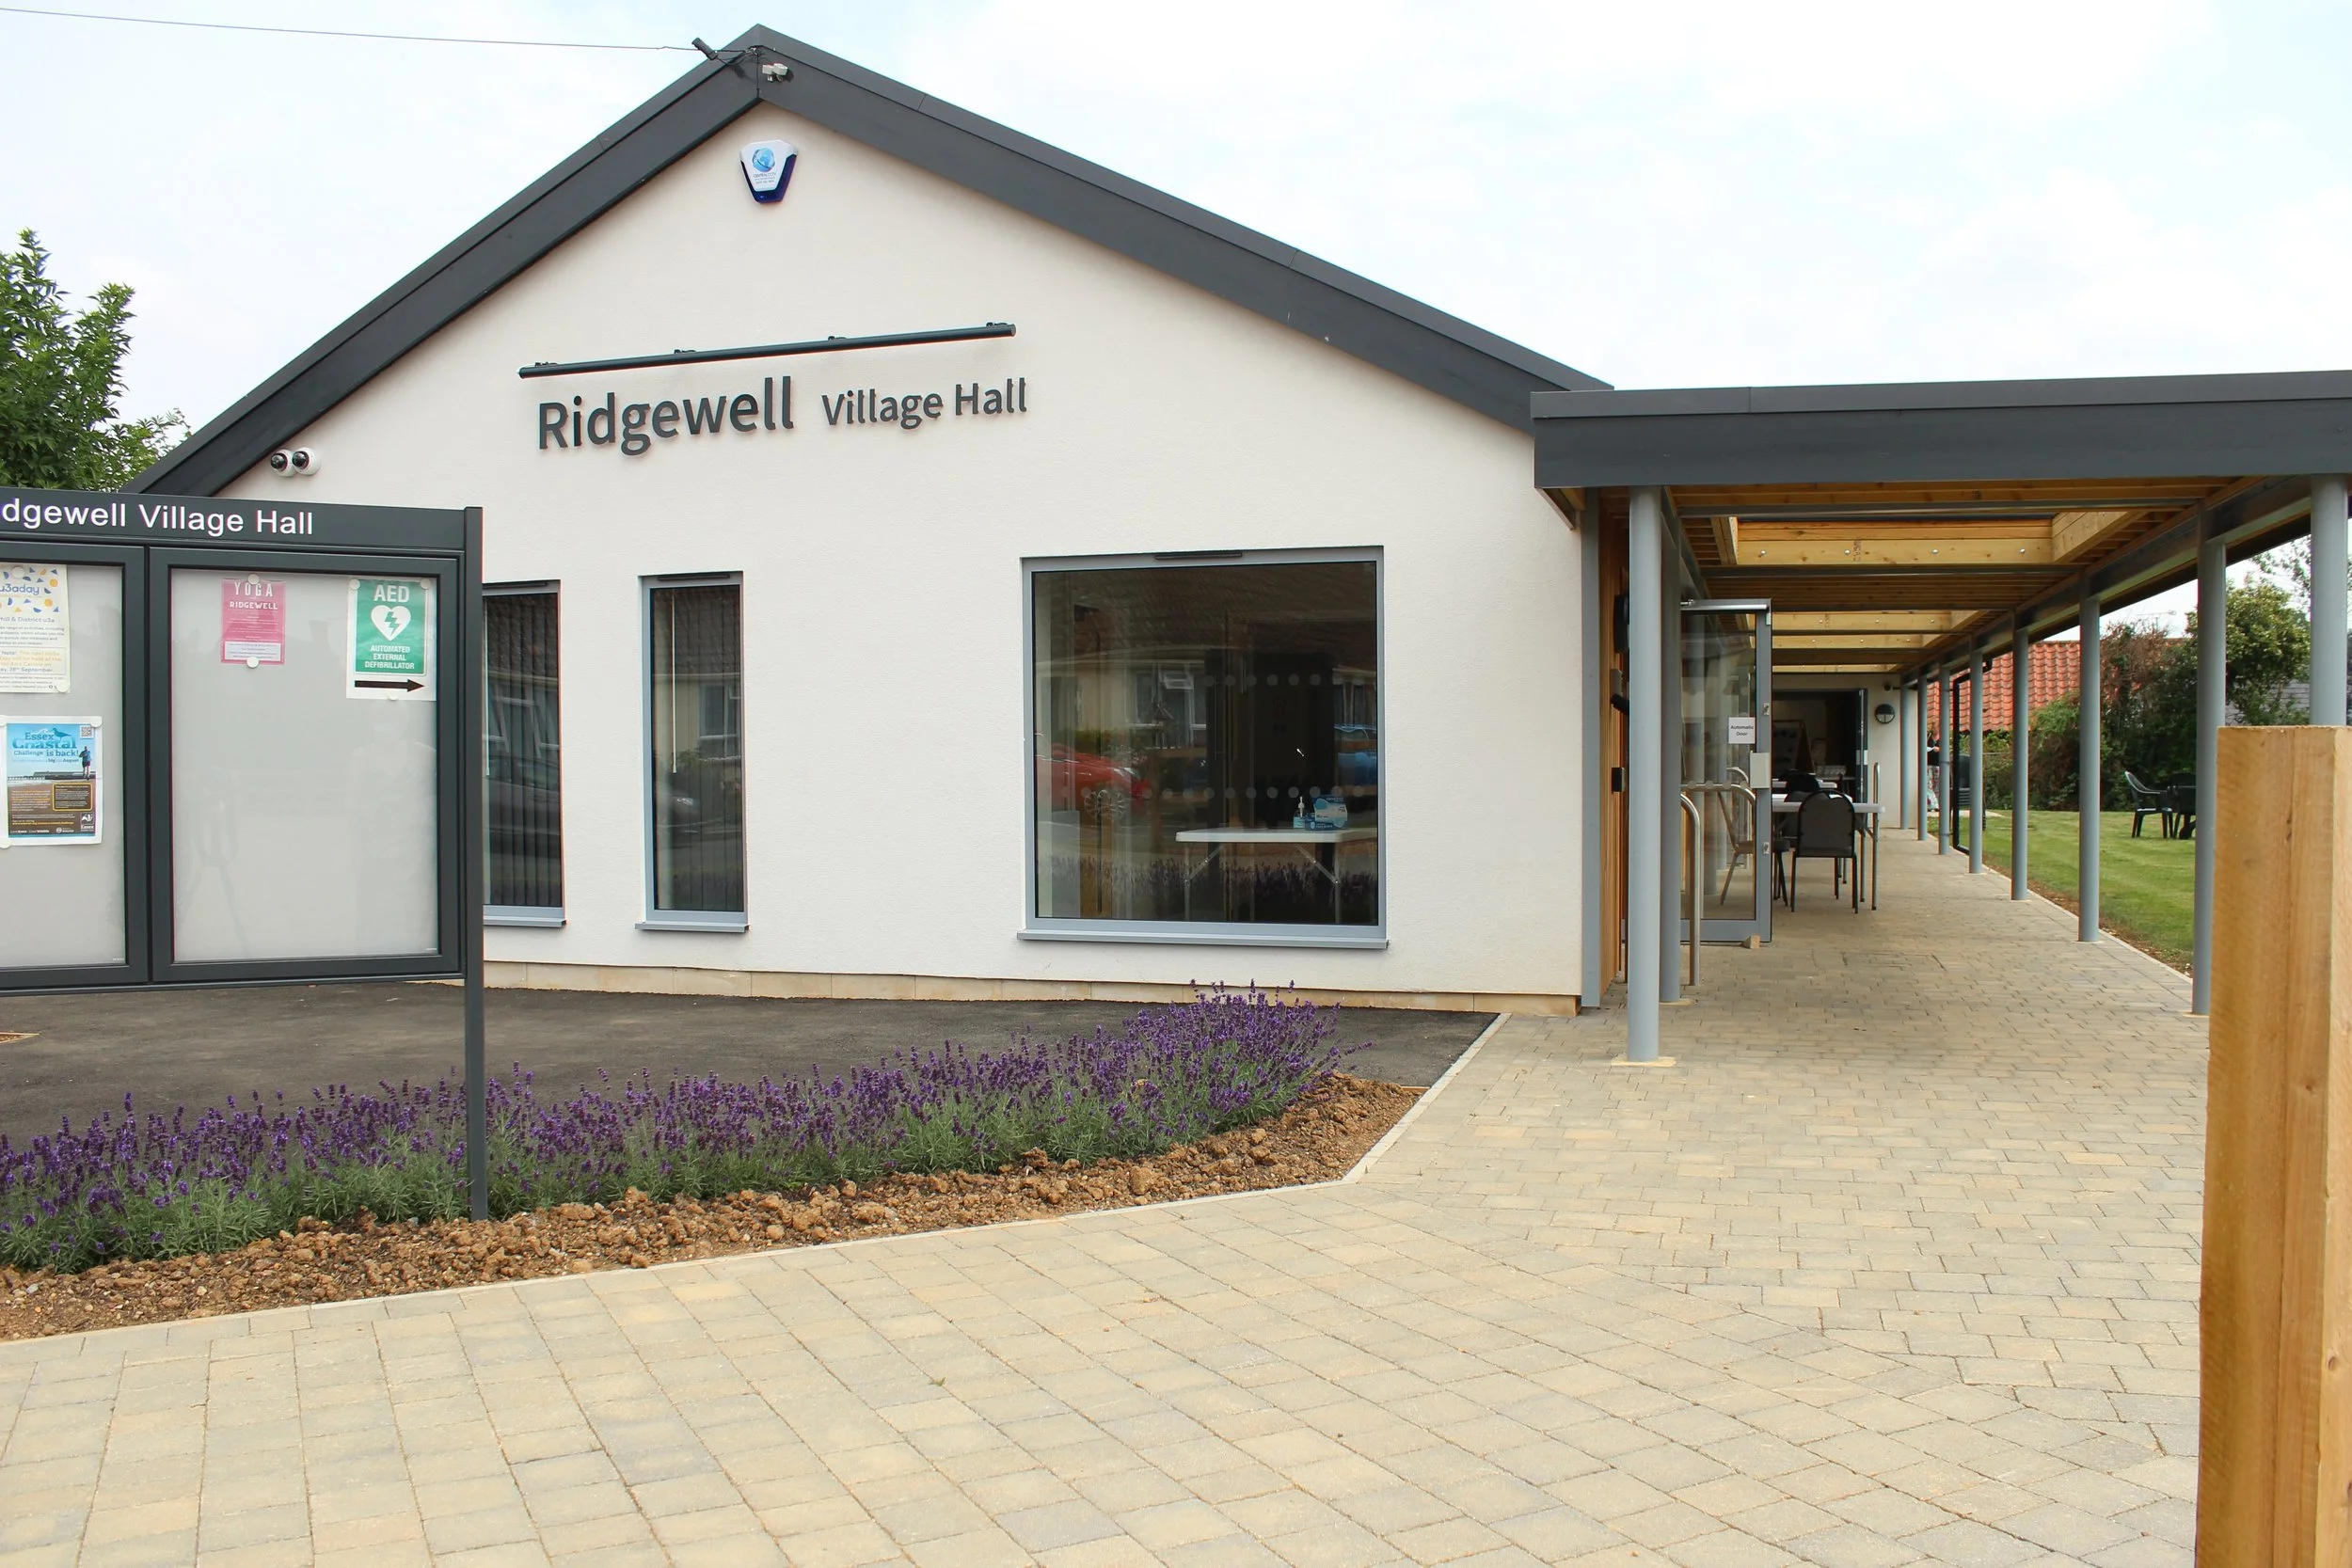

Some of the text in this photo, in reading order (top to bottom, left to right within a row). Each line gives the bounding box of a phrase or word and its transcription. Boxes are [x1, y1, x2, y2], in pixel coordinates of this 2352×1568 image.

[537, 375, 1027, 455] Ridgewell Village Hall
[2, 498, 313, 537] dgewell Village Hall
[234, 581, 273, 597] YOGA
[373, 584, 410, 603] AED
[230, 601, 278, 610] RIDGEWELL
[24, 732, 55, 740] Essex
